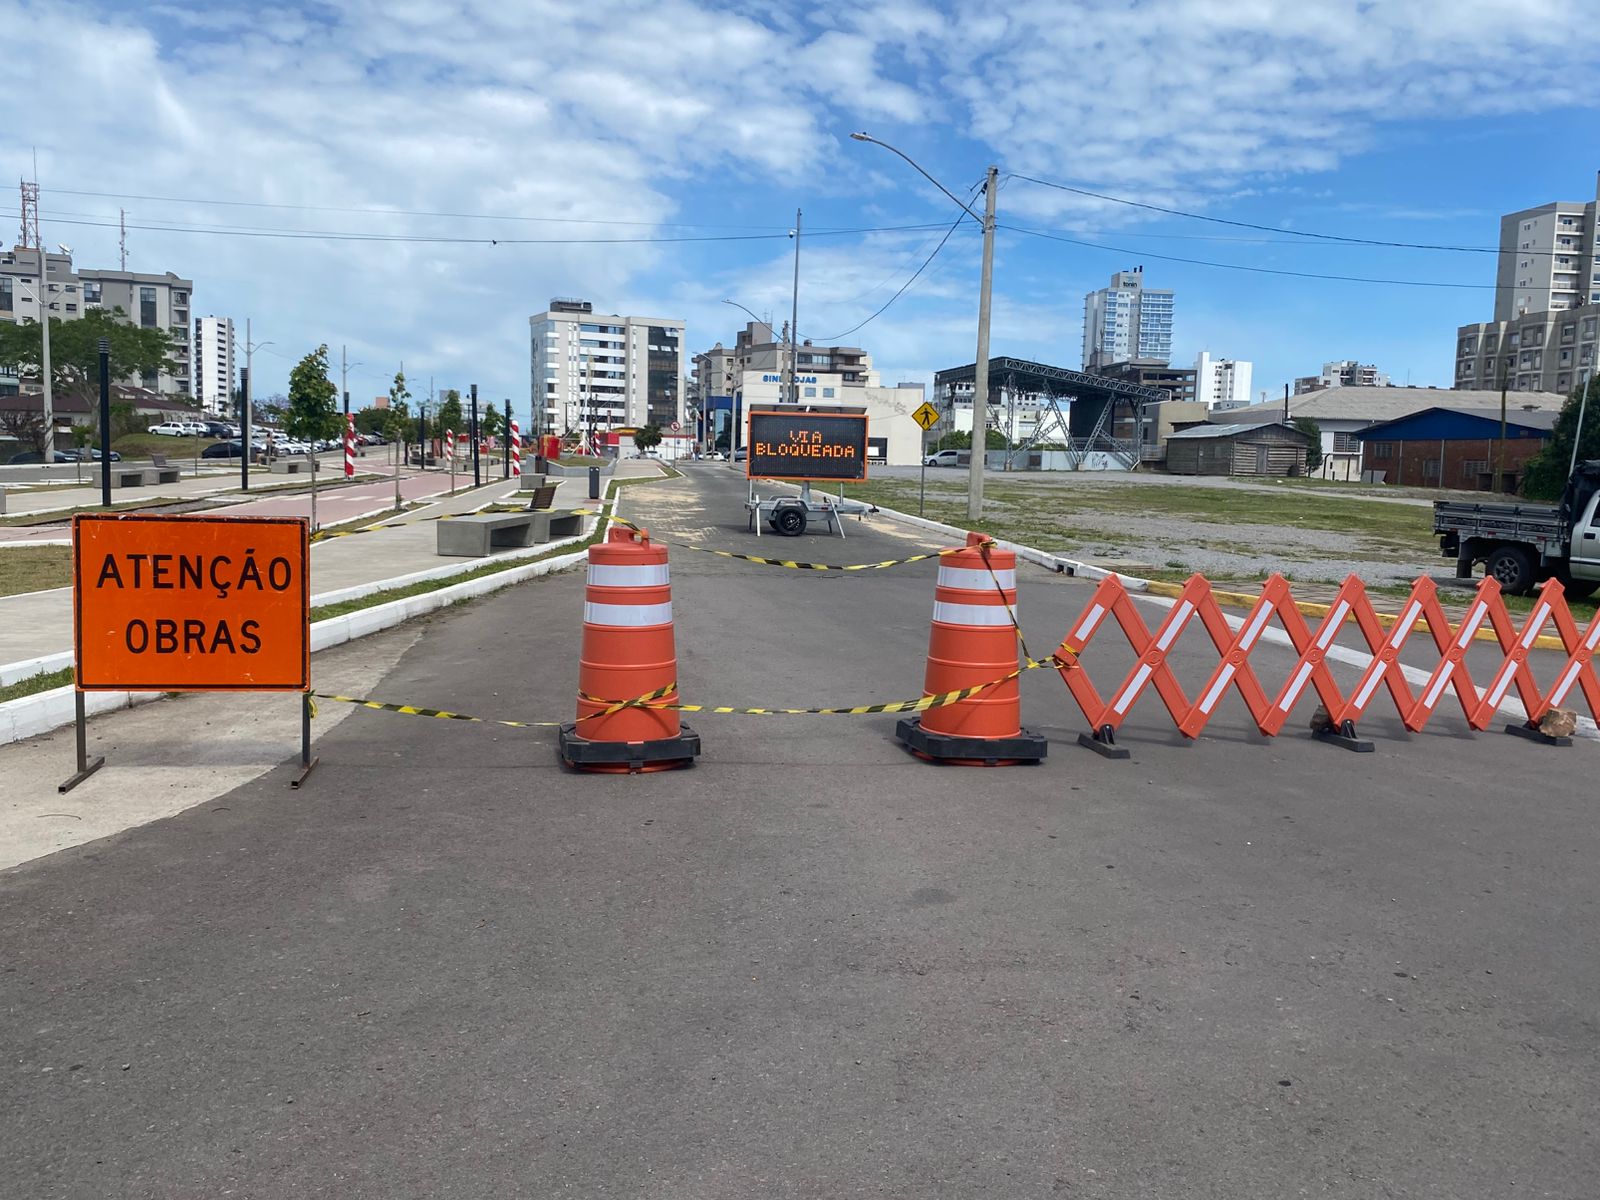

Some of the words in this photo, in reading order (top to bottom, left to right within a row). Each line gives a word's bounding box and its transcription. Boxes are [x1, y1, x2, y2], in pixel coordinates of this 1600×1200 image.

[763, 375, 816, 384] SINOJAS
[789, 430, 822, 443] VIA
[755, 442, 855, 458] BLOQUEADA
[97, 549, 292, 599] ATENÇÃO
[126, 619, 262, 654] OBRAS
